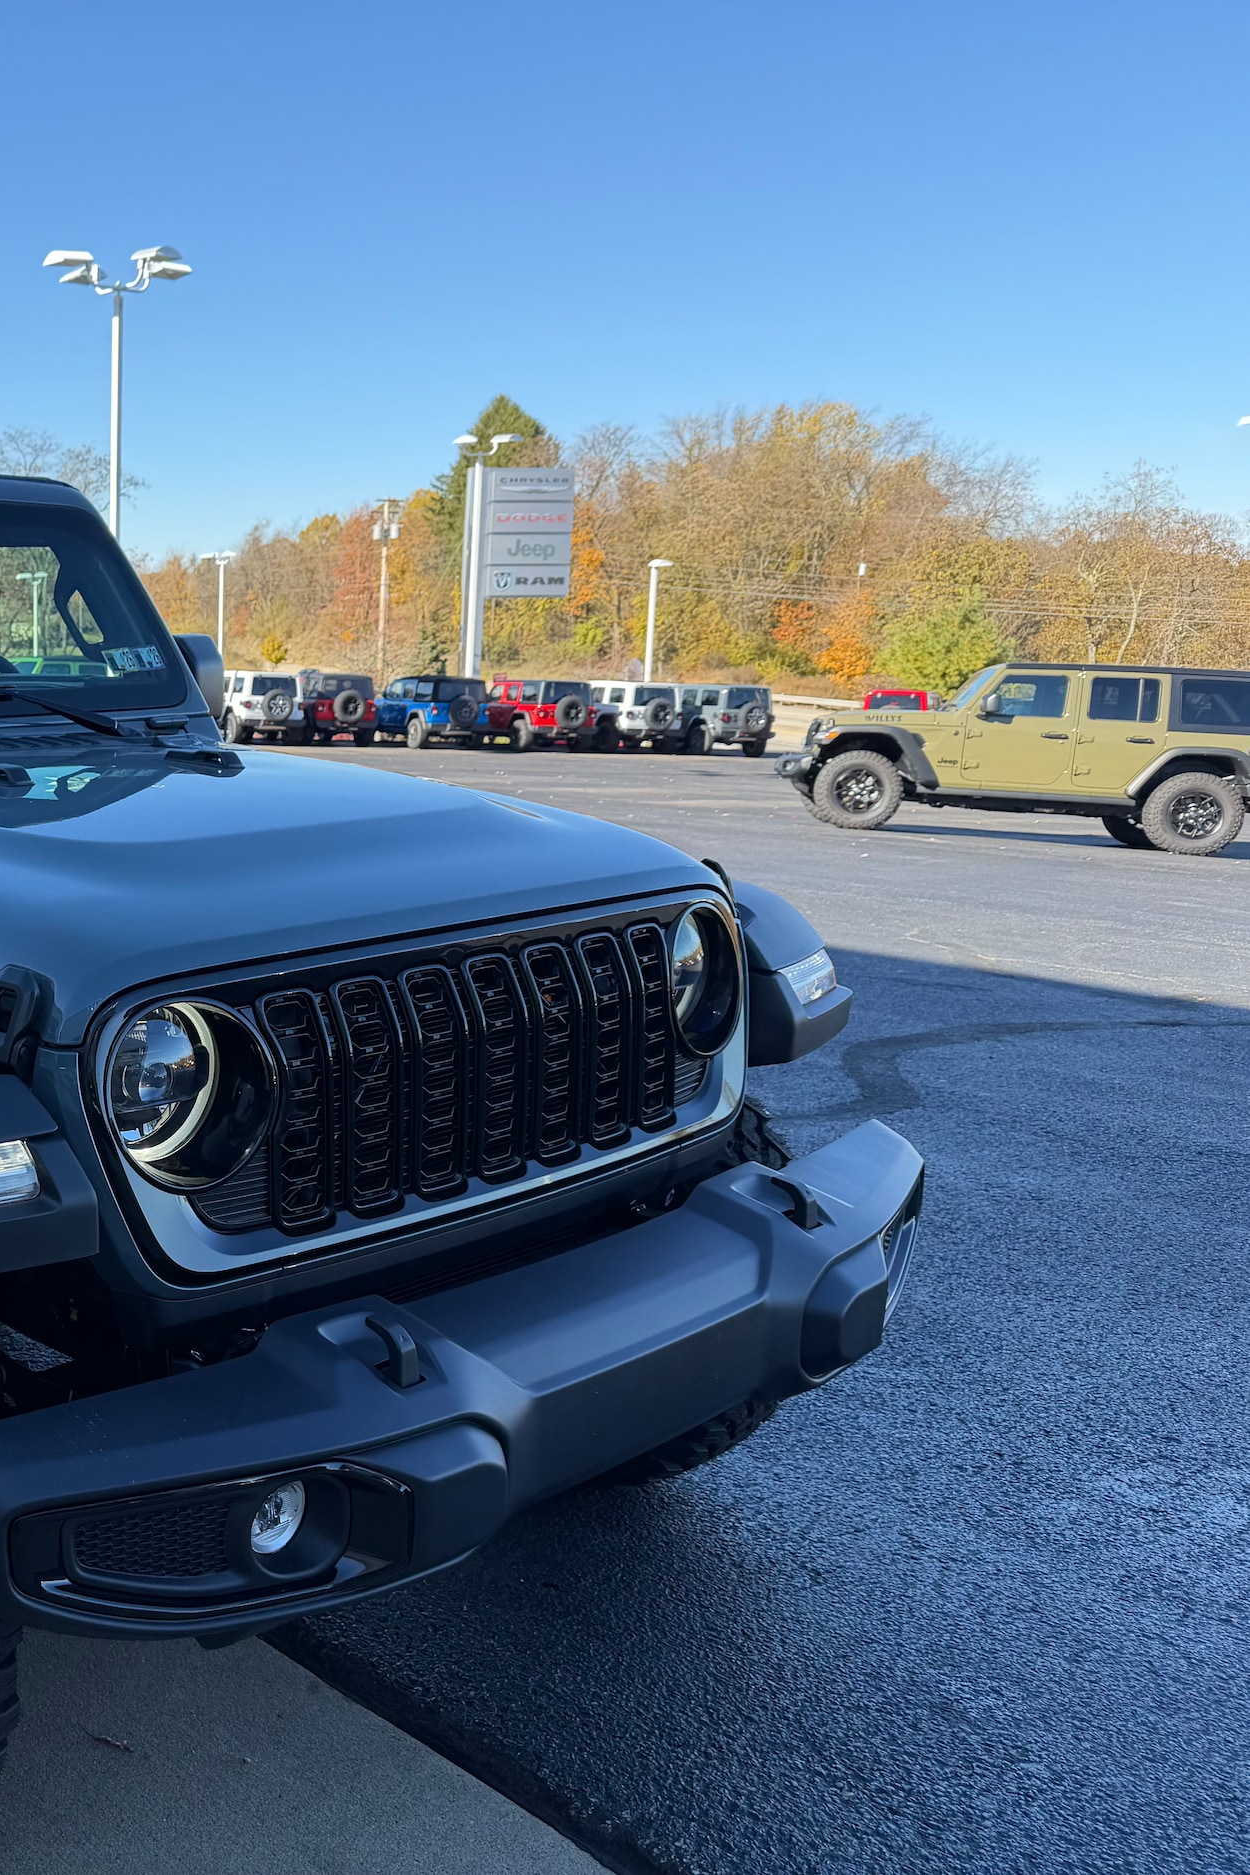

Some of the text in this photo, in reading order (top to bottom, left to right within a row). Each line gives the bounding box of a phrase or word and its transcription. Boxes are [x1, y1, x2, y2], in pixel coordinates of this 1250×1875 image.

[497, 513, 568, 523] DODGE
[507, 539, 556, 560] Jeep
[515, 576, 565, 585] RAM
[865, 714, 903, 722] WILLYS
[937, 757, 958, 766] Jeep
